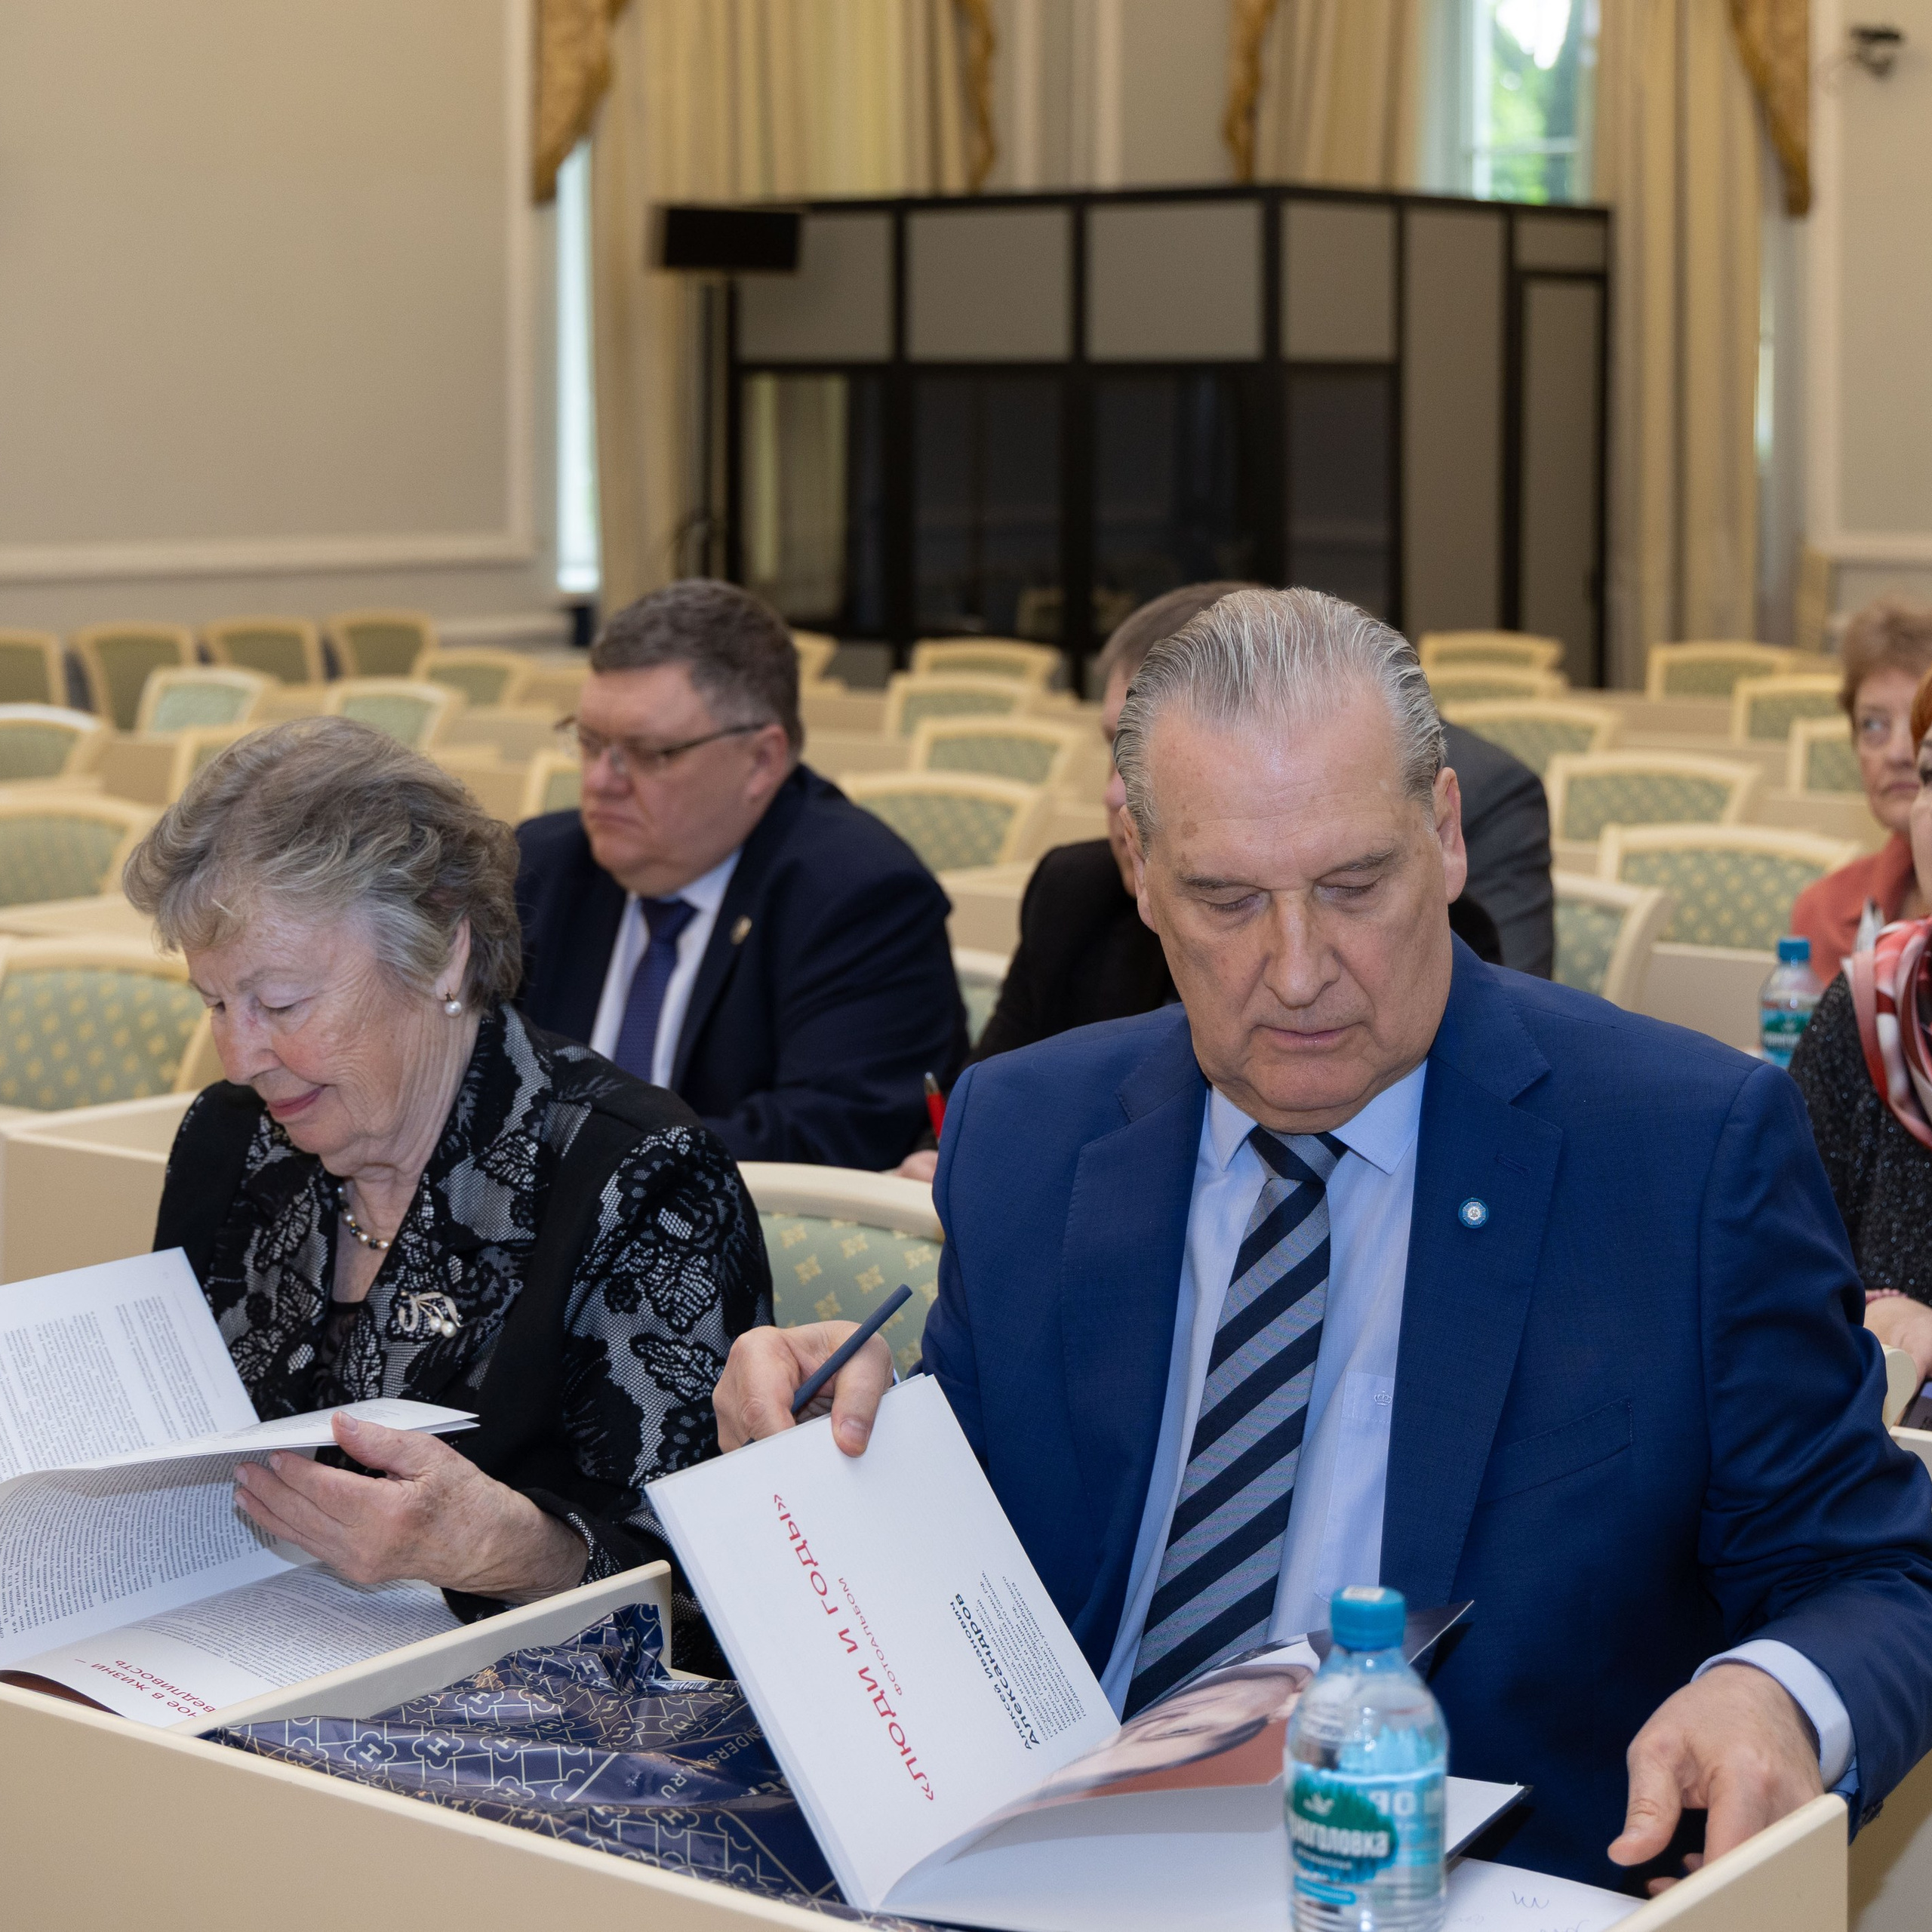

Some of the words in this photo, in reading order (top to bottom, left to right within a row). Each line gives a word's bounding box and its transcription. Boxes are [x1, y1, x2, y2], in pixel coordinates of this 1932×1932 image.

[29, 1531, 38, 1589] старшеклассника
[56, 1526, 65, 1568] Александров
[774, 1494, 838, 1614] ГОДЫ»
[78, 1580, 87, 1610] интереса
[84, 1565, 94, 1607] разобраться
[98, 1572, 107, 1603] ционного
[118, 1569, 126, 1596] Алексей
[982, 1571, 1003, 1609] созывов,
[30, 1592, 38, 1626] захватило
[45, 1594, 53, 1622] которая
[51, 1582, 60, 1620] вопросами
[988, 1595, 1004, 1620] Думы
[1012, 1607, 1020, 1619] РФ,
[838, 1577, 902, 1696] ФОТОАЛЬБОМ
[976, 1606, 992, 1635] юрист,
[1002, 1611, 1023, 1647] третьего
[838, 1628, 858, 1654] И
[950, 1601, 993, 1678] Иванович
[999, 1625, 1020, 1660] деятель,
[1020, 1620, 1043, 1661] Собрания
[91, 1663, 149, 1690] жизни
[955, 1594, 1040, 1744] Александров
[1028, 1657, 1048, 1690] второго
[1042, 1672, 1060, 1703] Совета
[994, 1684, 1032, 1749] Алексей
[1043, 1698, 1063, 1730] депутат
[1048, 1692, 1067, 1728] первого,
[1060, 1704, 1071, 1726] Член
[427, 1737, 450, 1755] H
[858, 1666, 934, 1801] «ЛЮДИ
[360, 1743, 382, 1763] H
